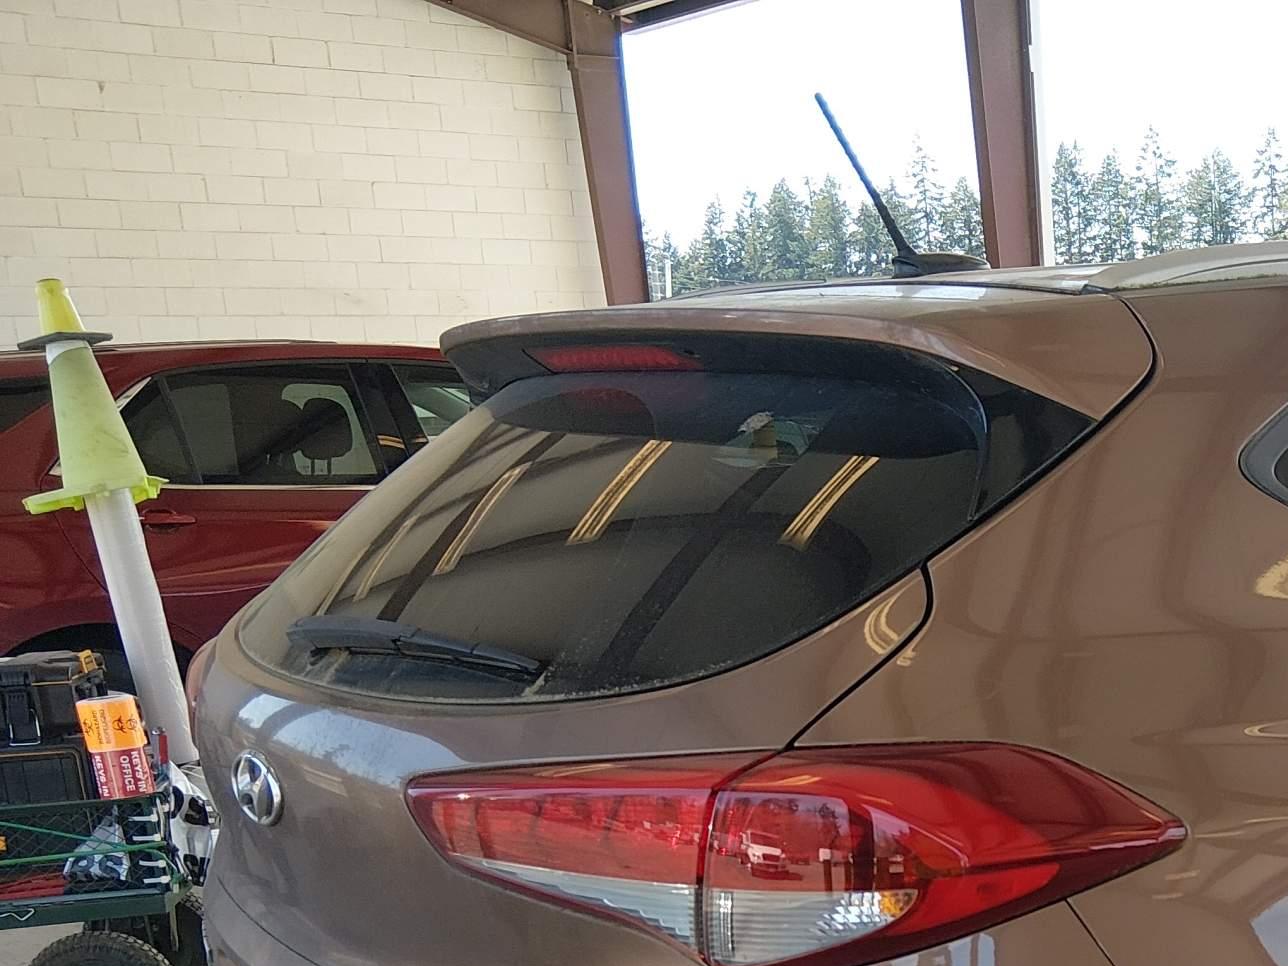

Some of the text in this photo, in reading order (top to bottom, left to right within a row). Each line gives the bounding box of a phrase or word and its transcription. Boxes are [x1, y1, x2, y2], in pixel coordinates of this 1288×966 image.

[94, 755, 107, 783] KEYS
[101, 785, 111, 797] IN
[119, 755, 136, 793] OFFICE
[131, 750, 148, 793] KEYS IN
